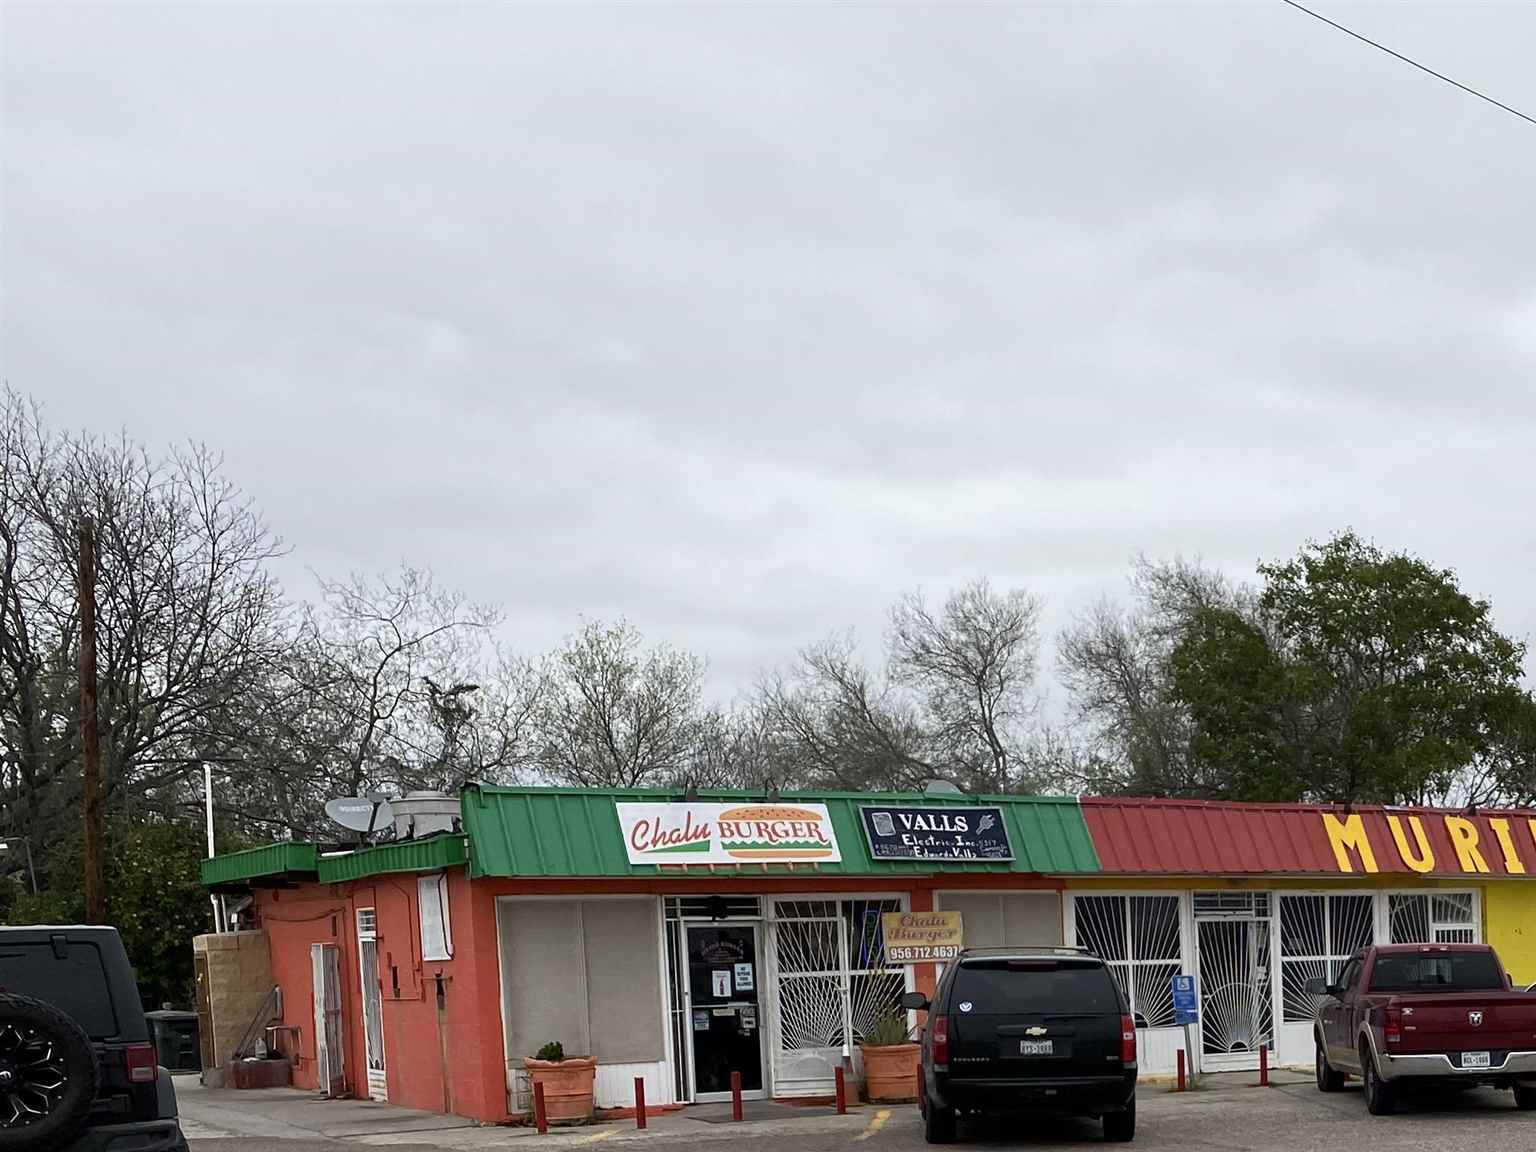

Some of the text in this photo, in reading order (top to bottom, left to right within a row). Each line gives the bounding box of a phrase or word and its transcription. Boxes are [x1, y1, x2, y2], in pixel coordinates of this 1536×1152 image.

[898, 813, 969, 832] VALLS
[717, 821, 828, 844] BURGER
[890, 946, 958, 960] 956.712.4637
